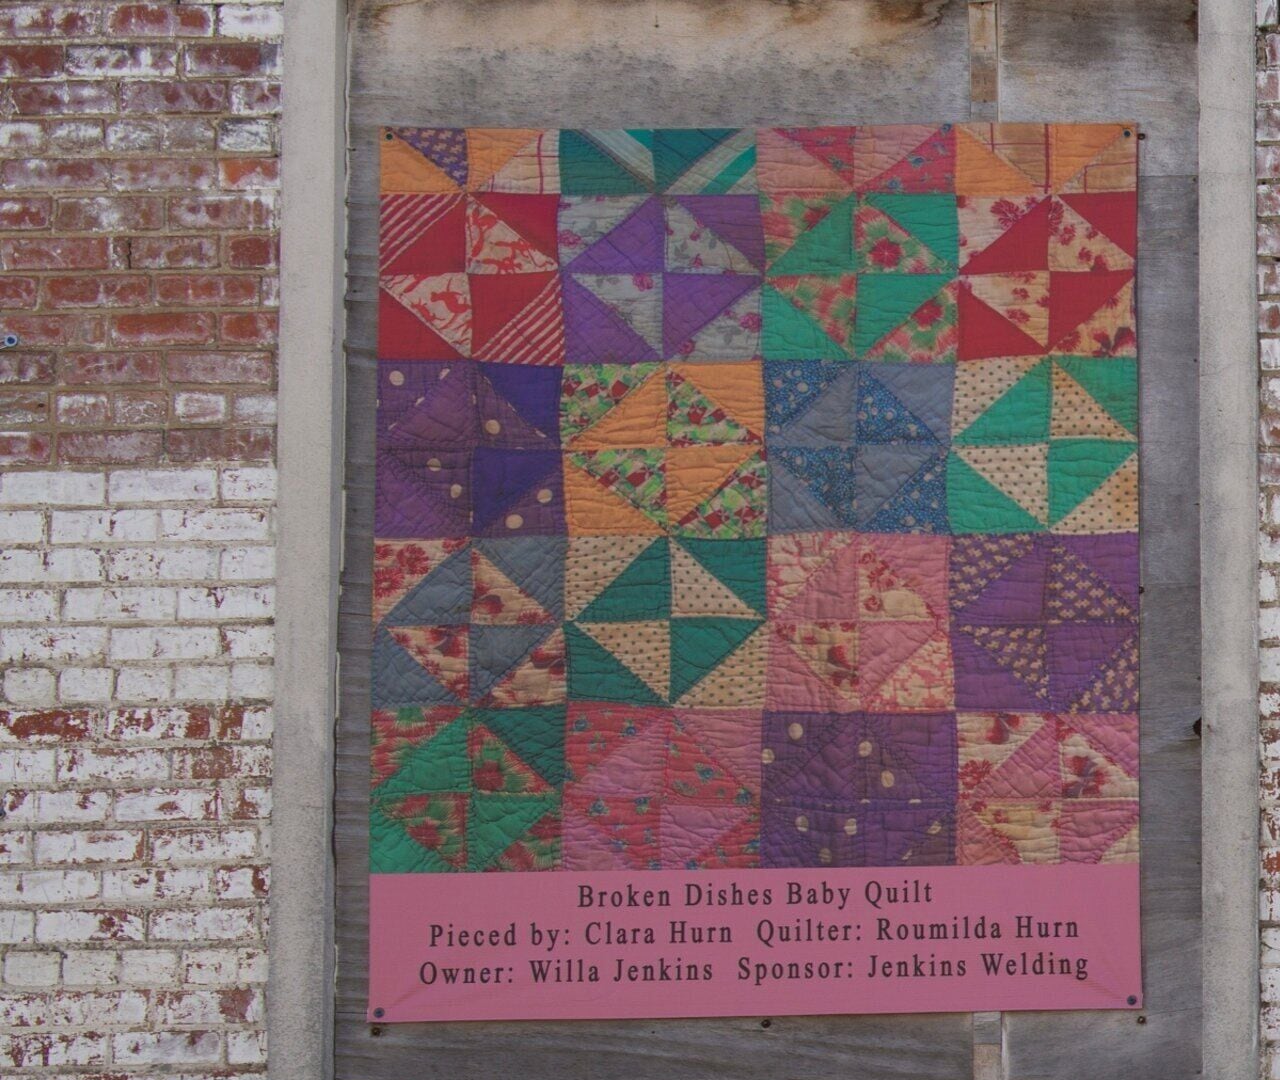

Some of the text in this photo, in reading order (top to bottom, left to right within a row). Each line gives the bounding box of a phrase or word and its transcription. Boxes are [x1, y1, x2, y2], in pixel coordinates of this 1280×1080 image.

[577, 879, 932, 911] Broken Dishes Baby Quilt
[429, 915, 1079, 952] Pieced by: Clara Hurn Quilter: Roumilda Hurn
[419, 951, 1089, 986] Owner: Willa Jenkins Sponsor: Jenkins Welding
